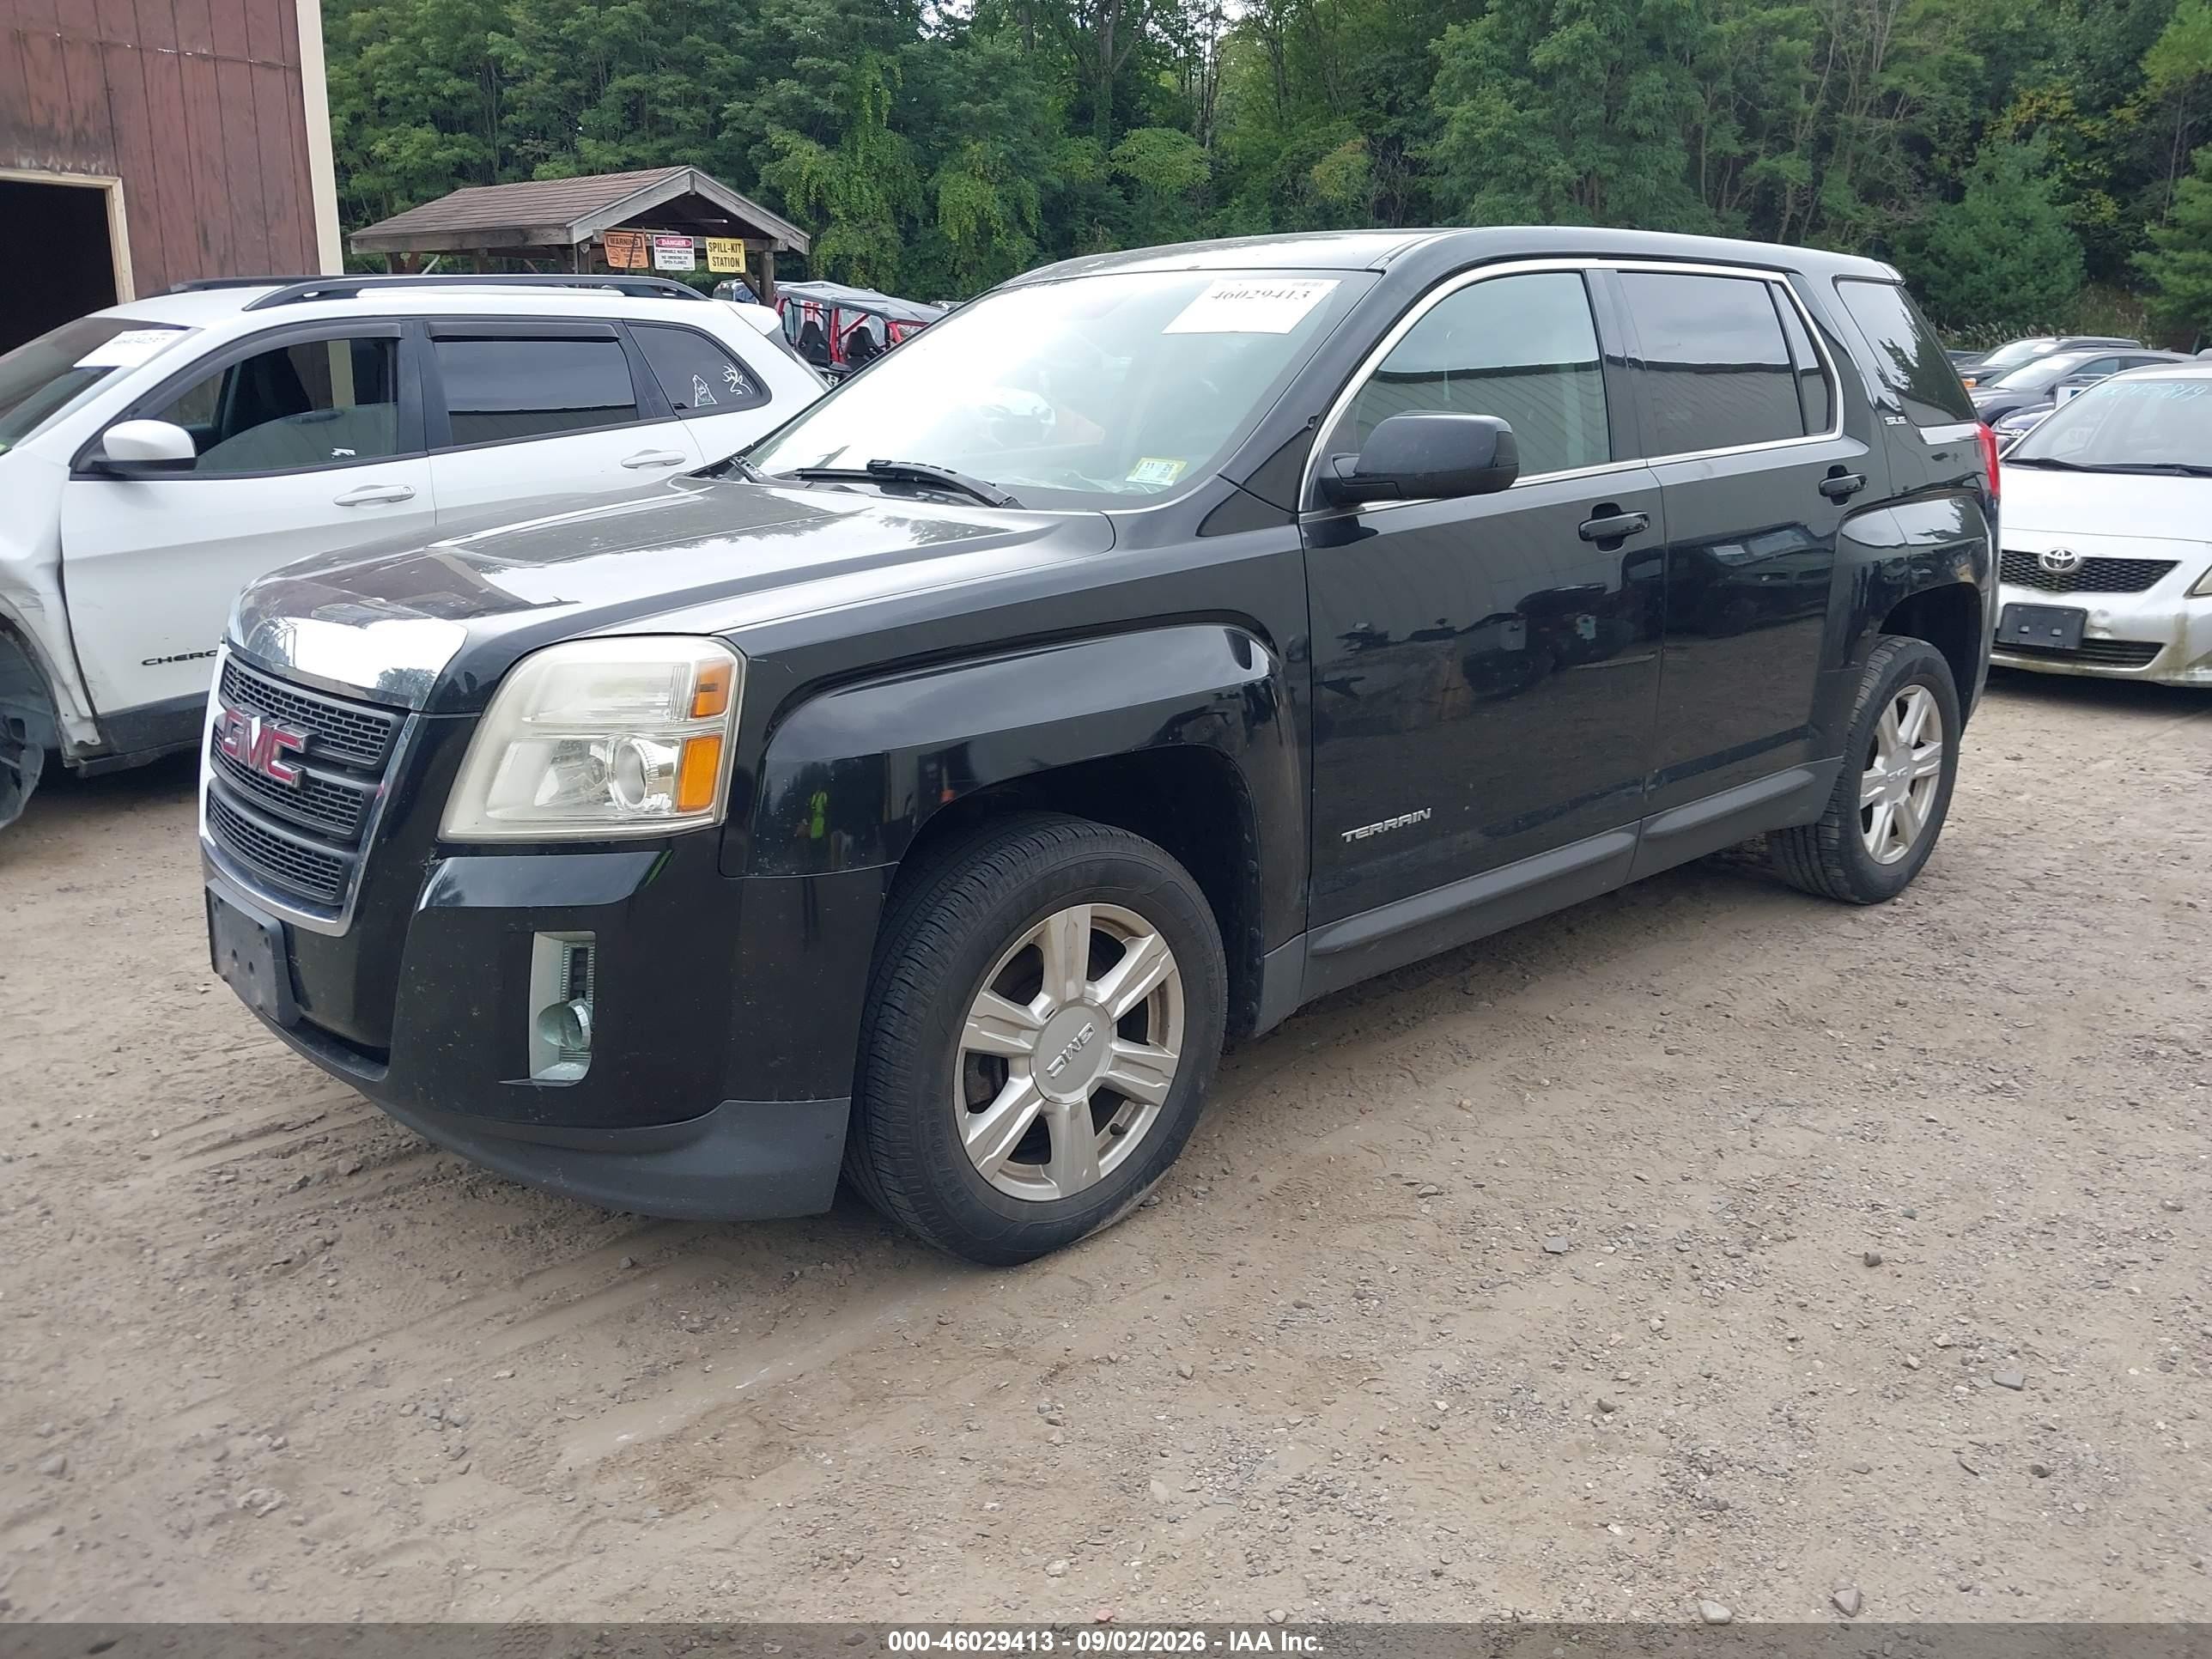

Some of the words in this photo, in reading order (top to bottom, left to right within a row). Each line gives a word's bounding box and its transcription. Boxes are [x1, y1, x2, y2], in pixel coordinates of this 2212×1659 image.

[708, 241, 742, 253] SPILL-KIT
[712, 256, 740, 268] STATION
[1211, 289, 1311, 300] 46029413
[221, 705, 306, 788] GMC
[1340, 807, 1431, 842] TERRAIN
[1046, 1022, 1096, 1079] GMC
